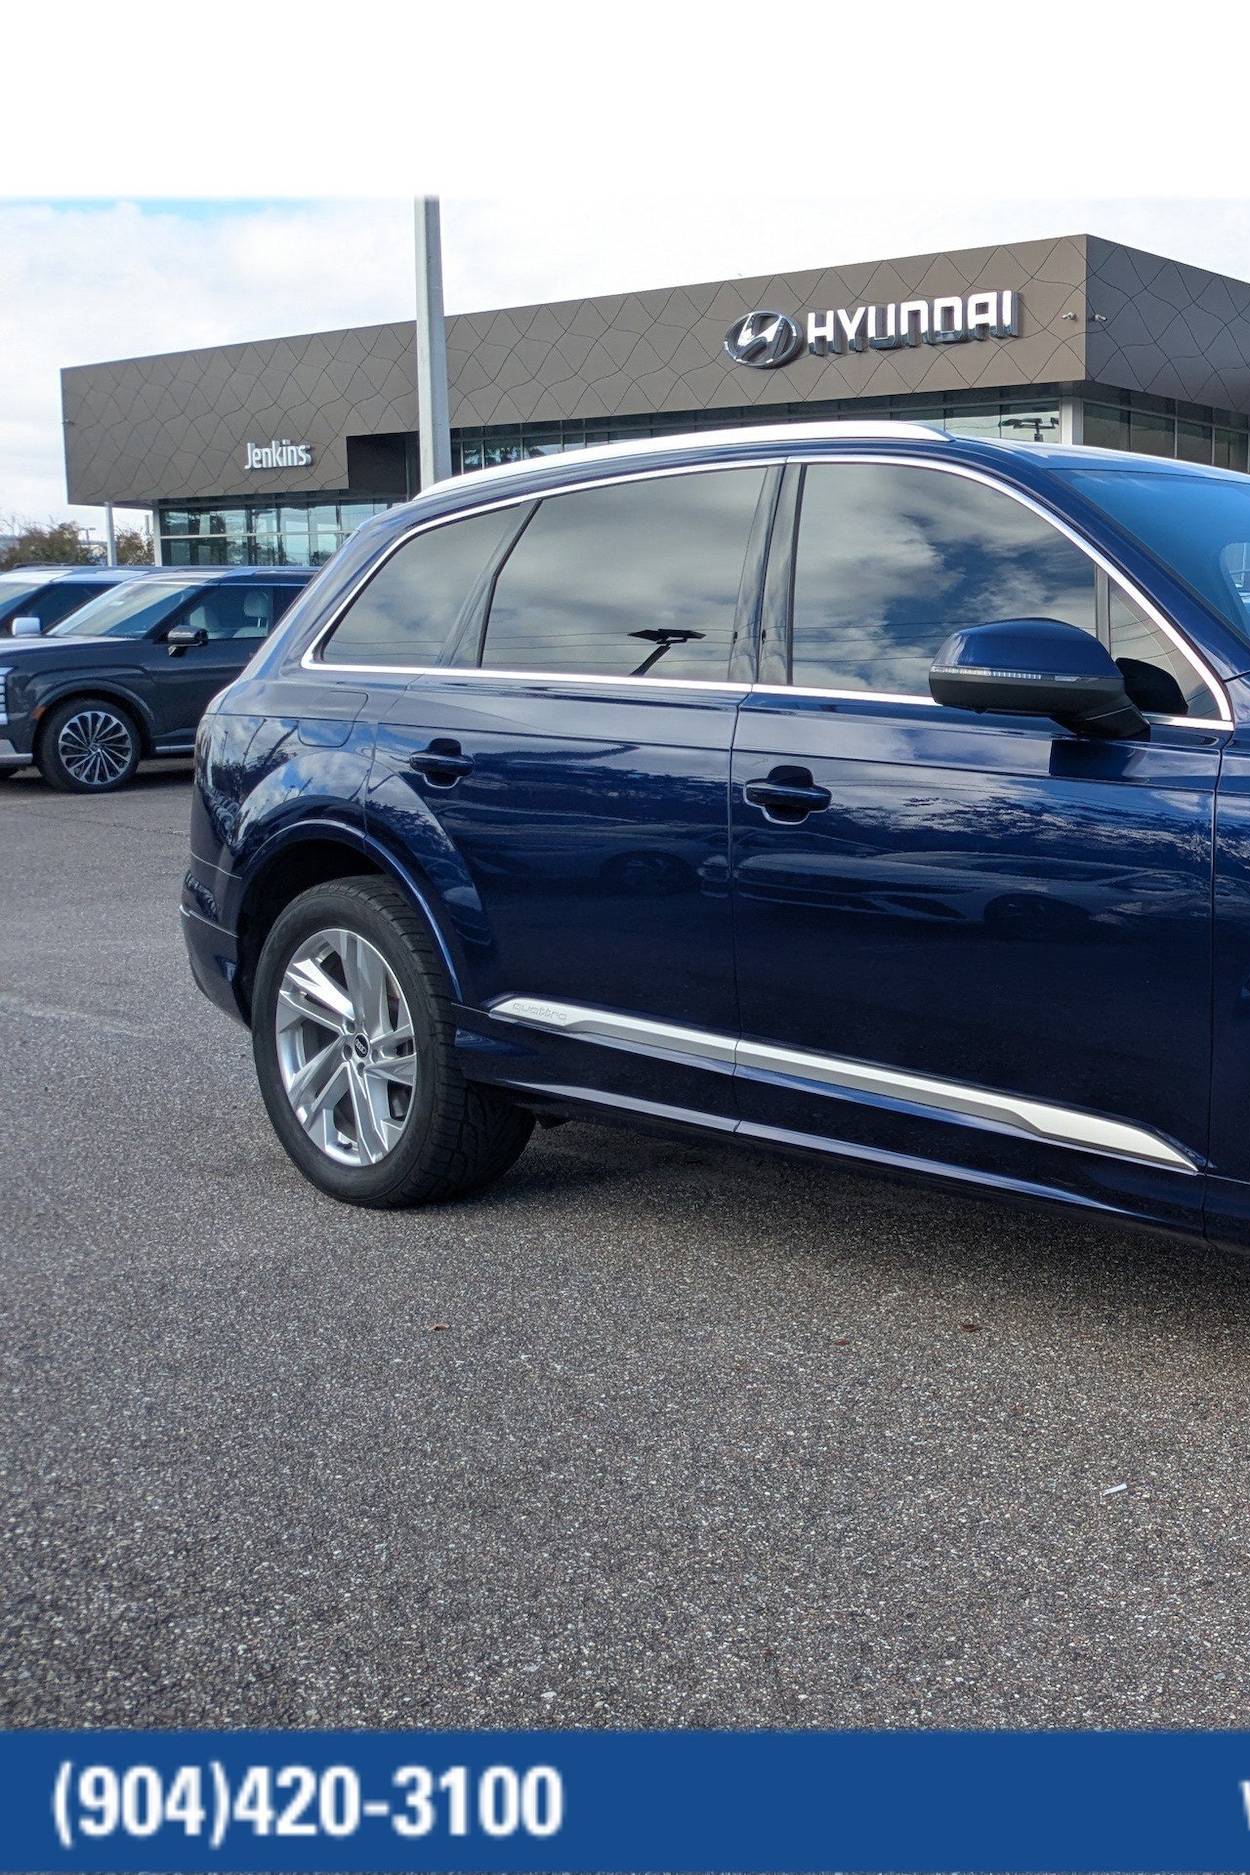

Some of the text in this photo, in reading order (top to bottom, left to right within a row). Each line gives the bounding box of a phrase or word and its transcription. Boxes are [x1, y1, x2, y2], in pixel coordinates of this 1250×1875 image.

[807, 290, 1019, 356] HYUNDAI
[244, 439, 312, 470] Jenkins
[513, 1003, 567, 1020] quattro
